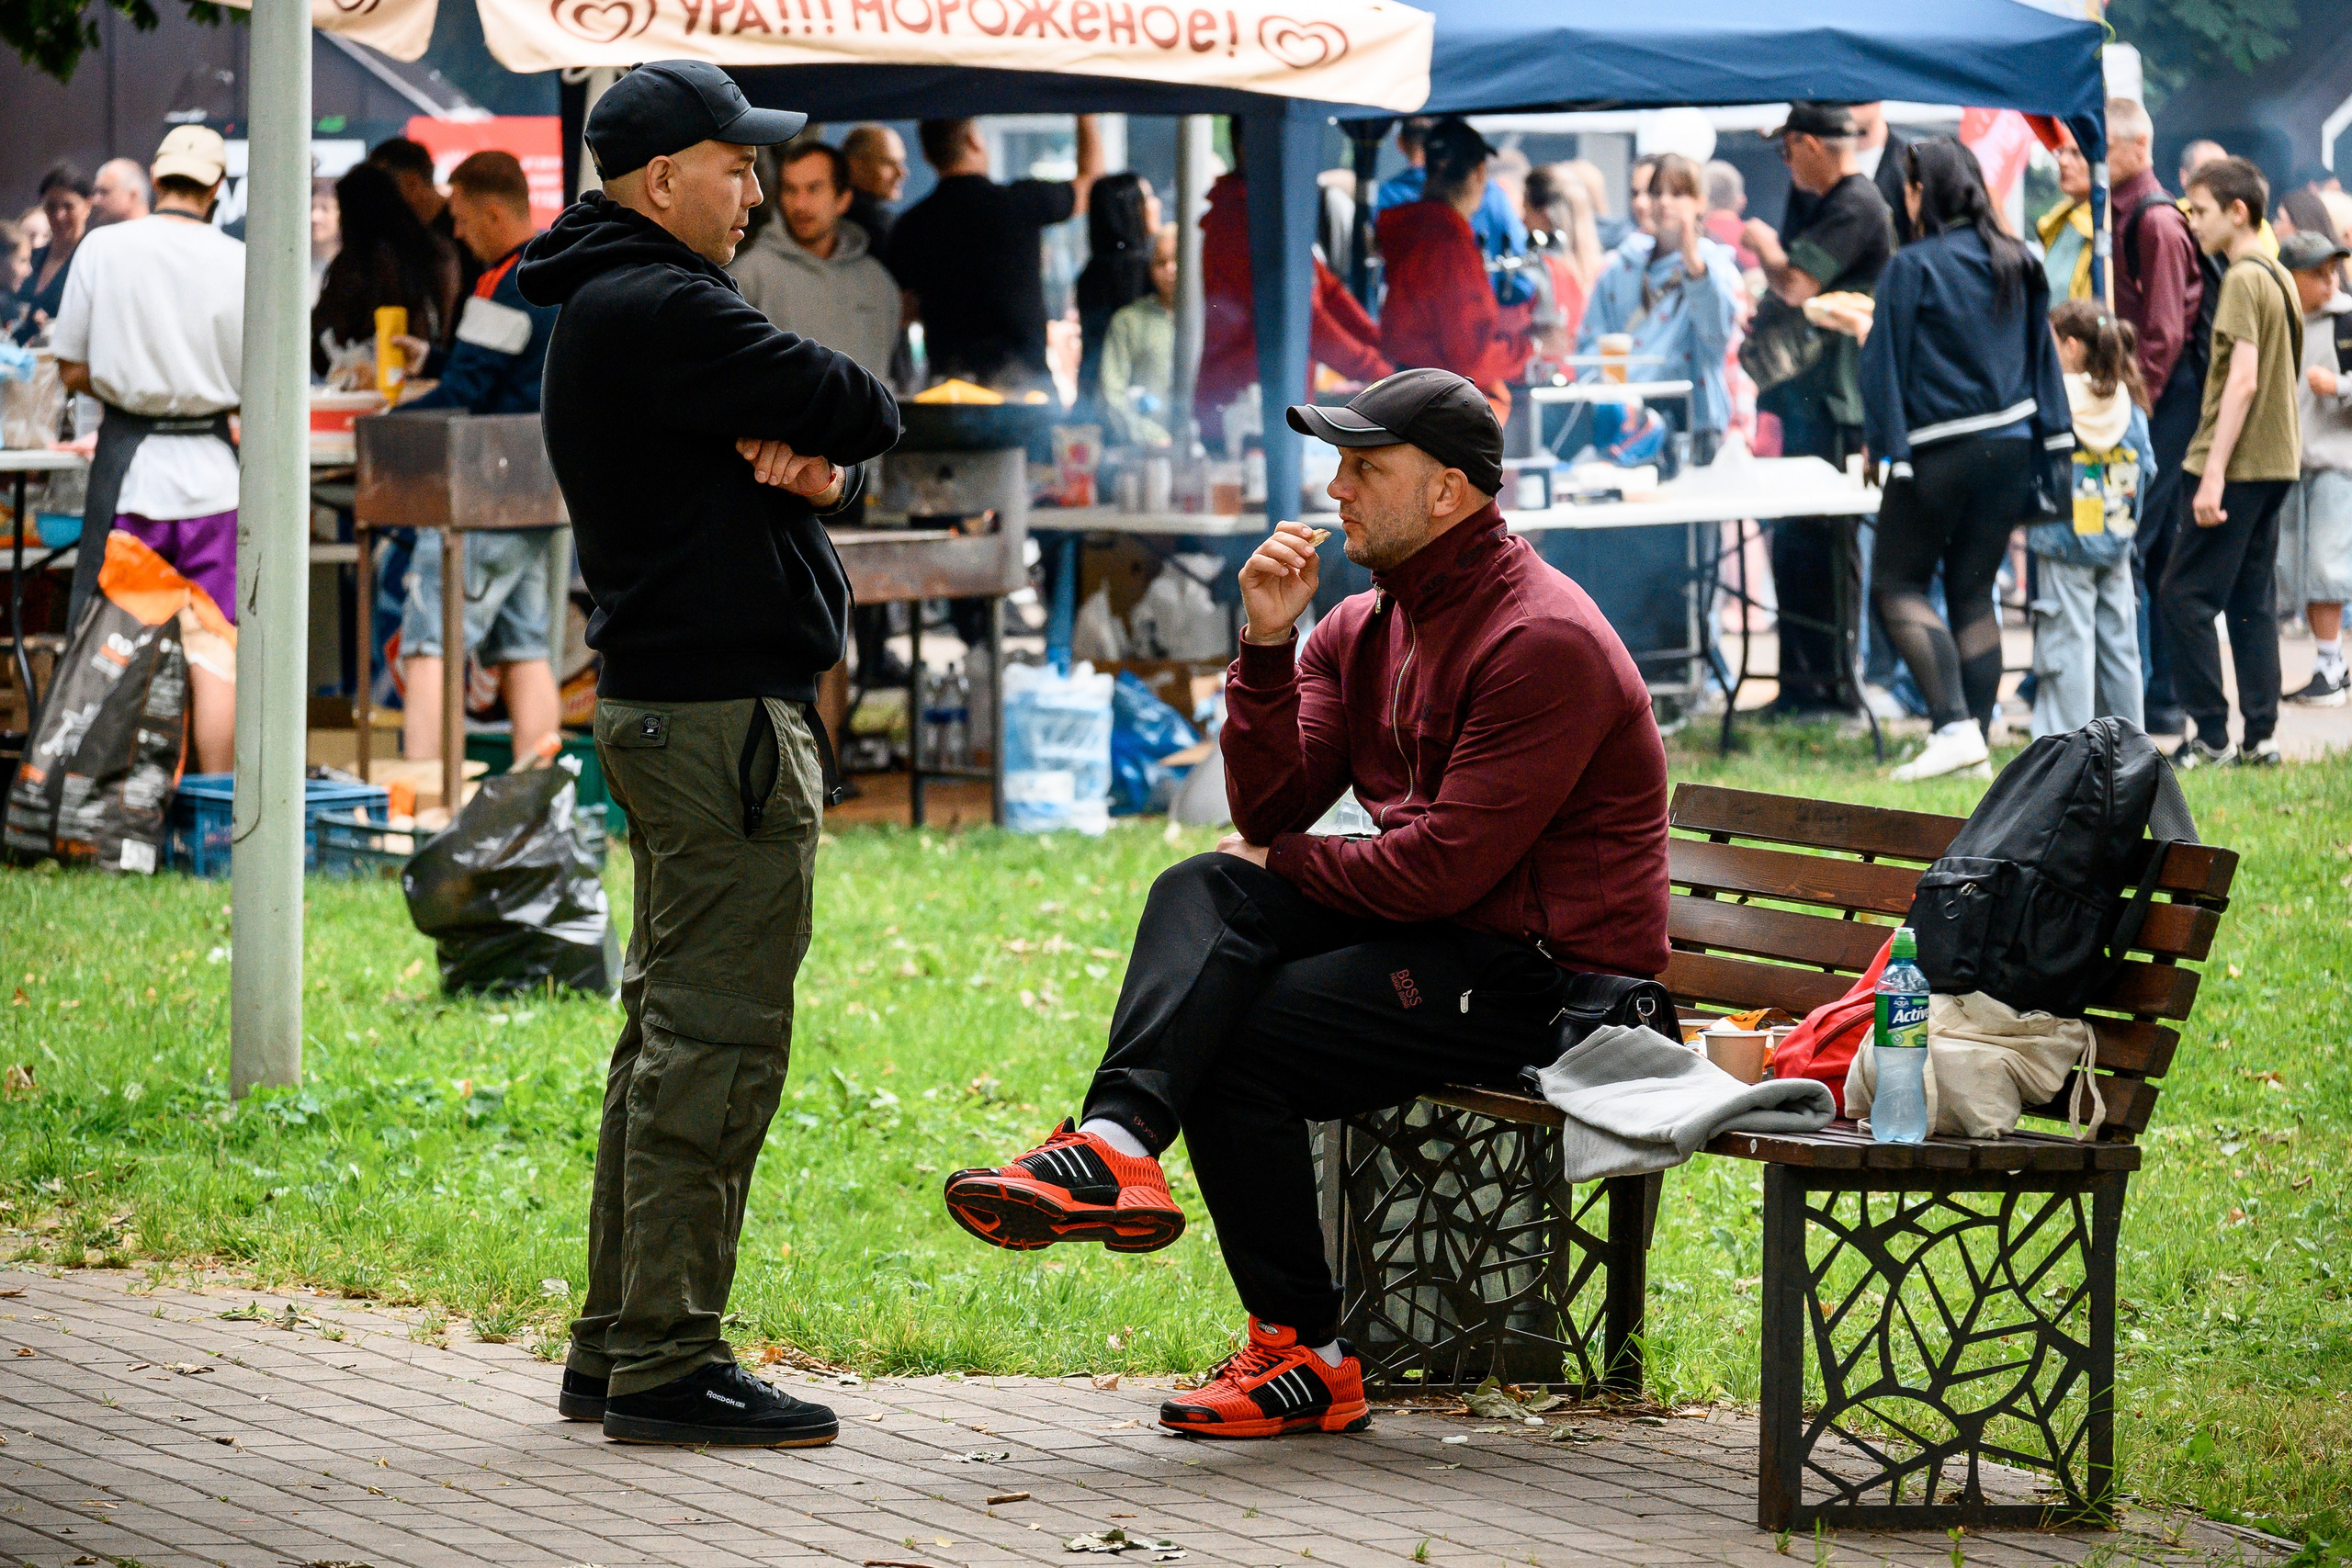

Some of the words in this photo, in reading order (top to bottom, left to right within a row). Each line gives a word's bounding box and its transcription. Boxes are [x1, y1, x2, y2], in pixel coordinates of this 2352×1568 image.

[1389, 972, 1402, 991] HUGO
[1396, 968, 1422, 1007] BOSS
[707, 1389, 736, 1406] Reebok
